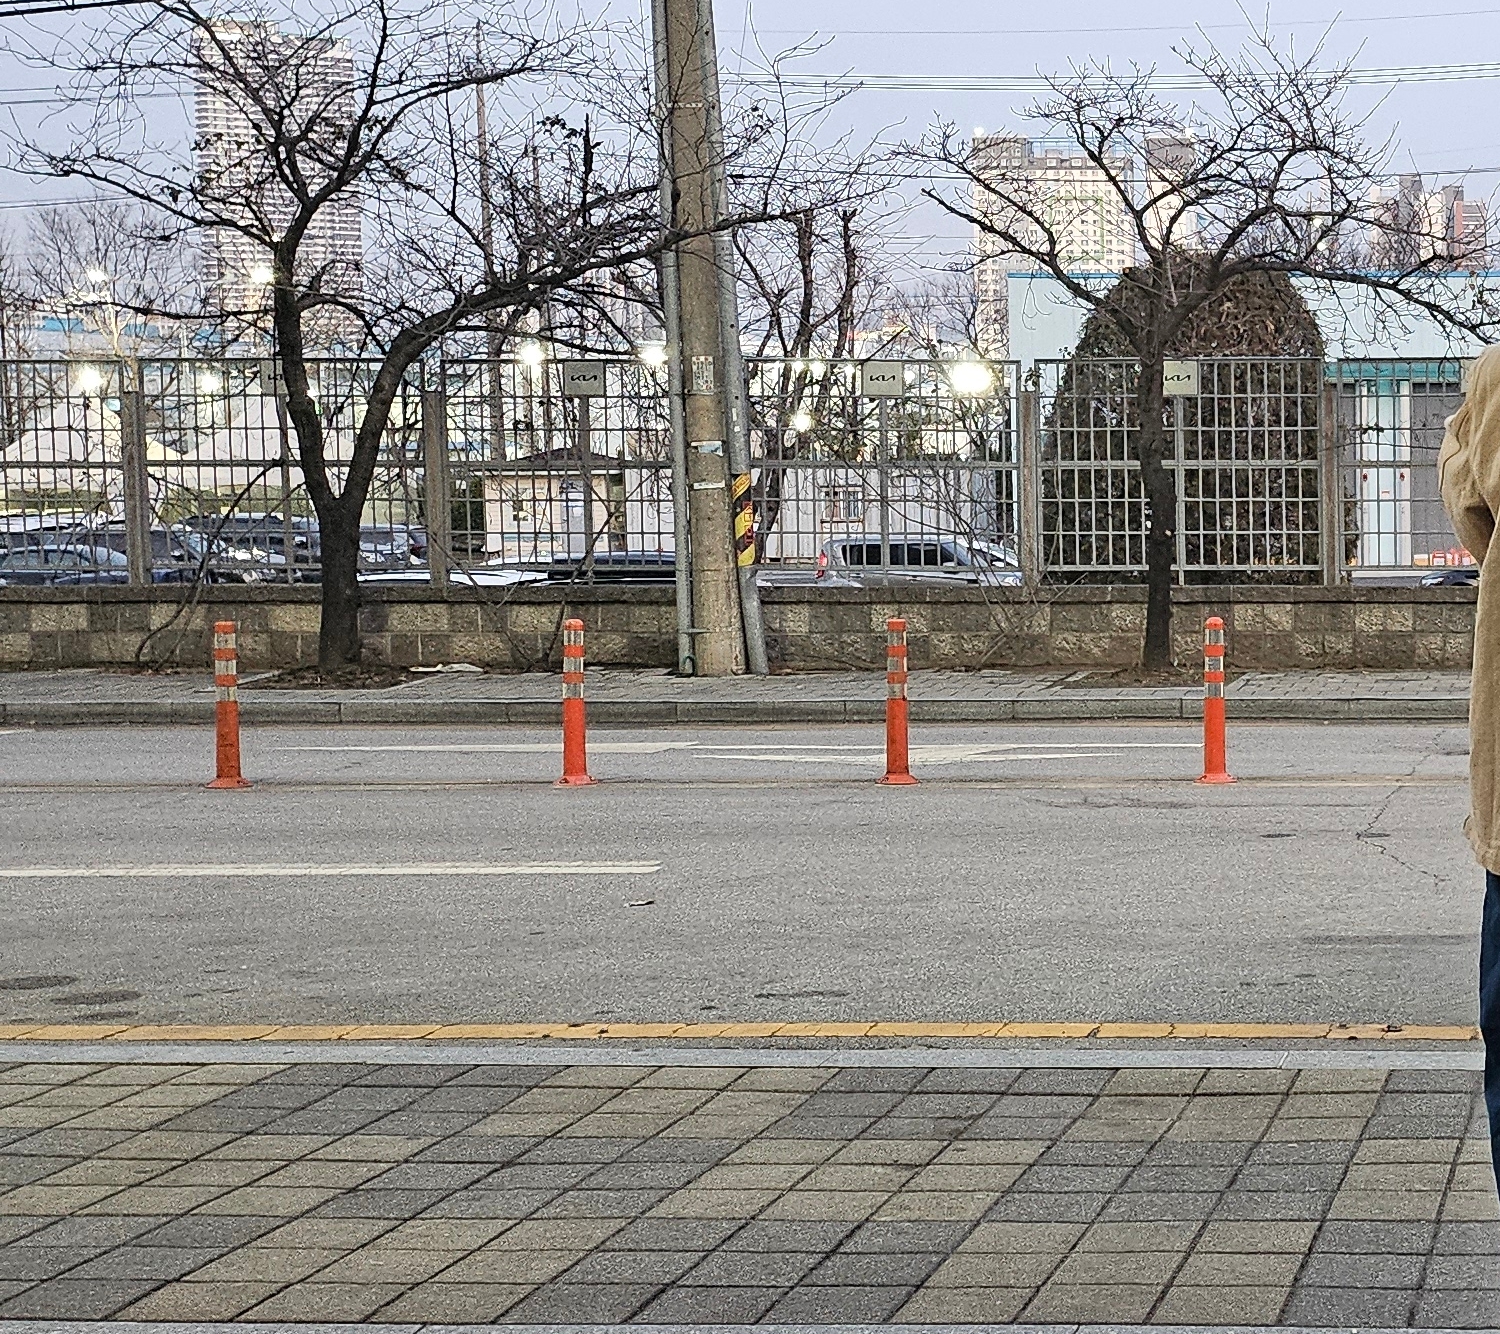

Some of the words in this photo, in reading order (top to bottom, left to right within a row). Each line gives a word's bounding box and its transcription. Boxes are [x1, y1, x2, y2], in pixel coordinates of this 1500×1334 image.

[570, 374, 598, 382] KIA
[869, 374, 896, 382] KIA
[1164, 374, 1191, 382] KIA
